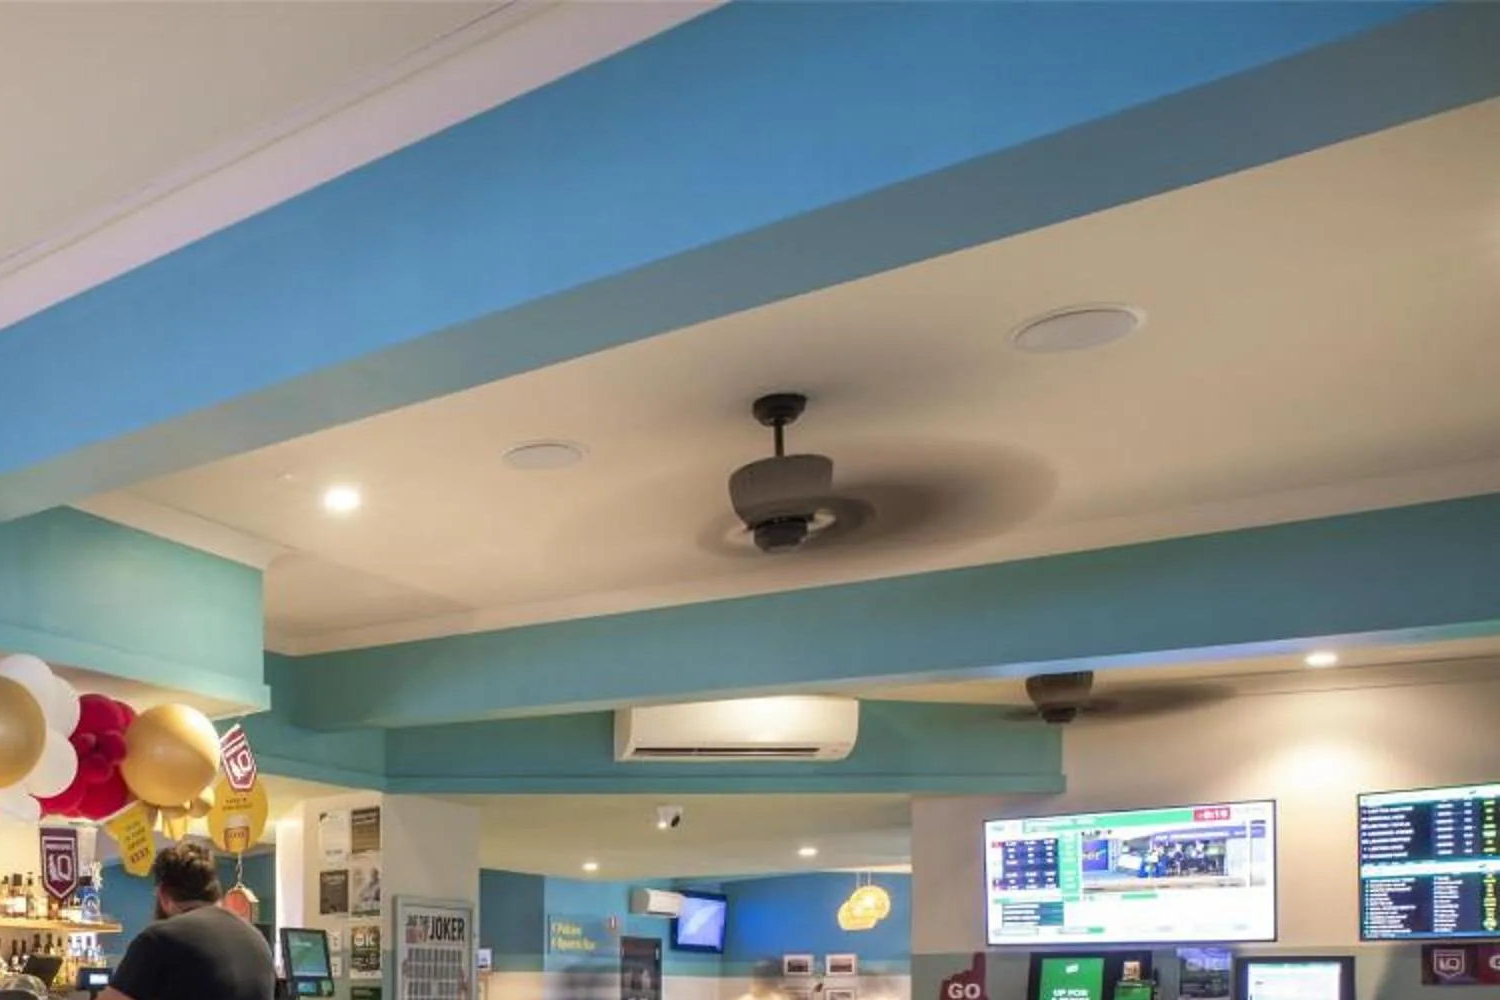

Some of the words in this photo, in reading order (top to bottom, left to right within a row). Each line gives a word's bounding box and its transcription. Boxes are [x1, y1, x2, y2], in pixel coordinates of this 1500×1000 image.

[430, 916, 466, 942] JOKER
[947, 982, 981, 999] GO
[1053, 989, 1067, 997] UP
[1068, 989, 1090, 997] FOR
